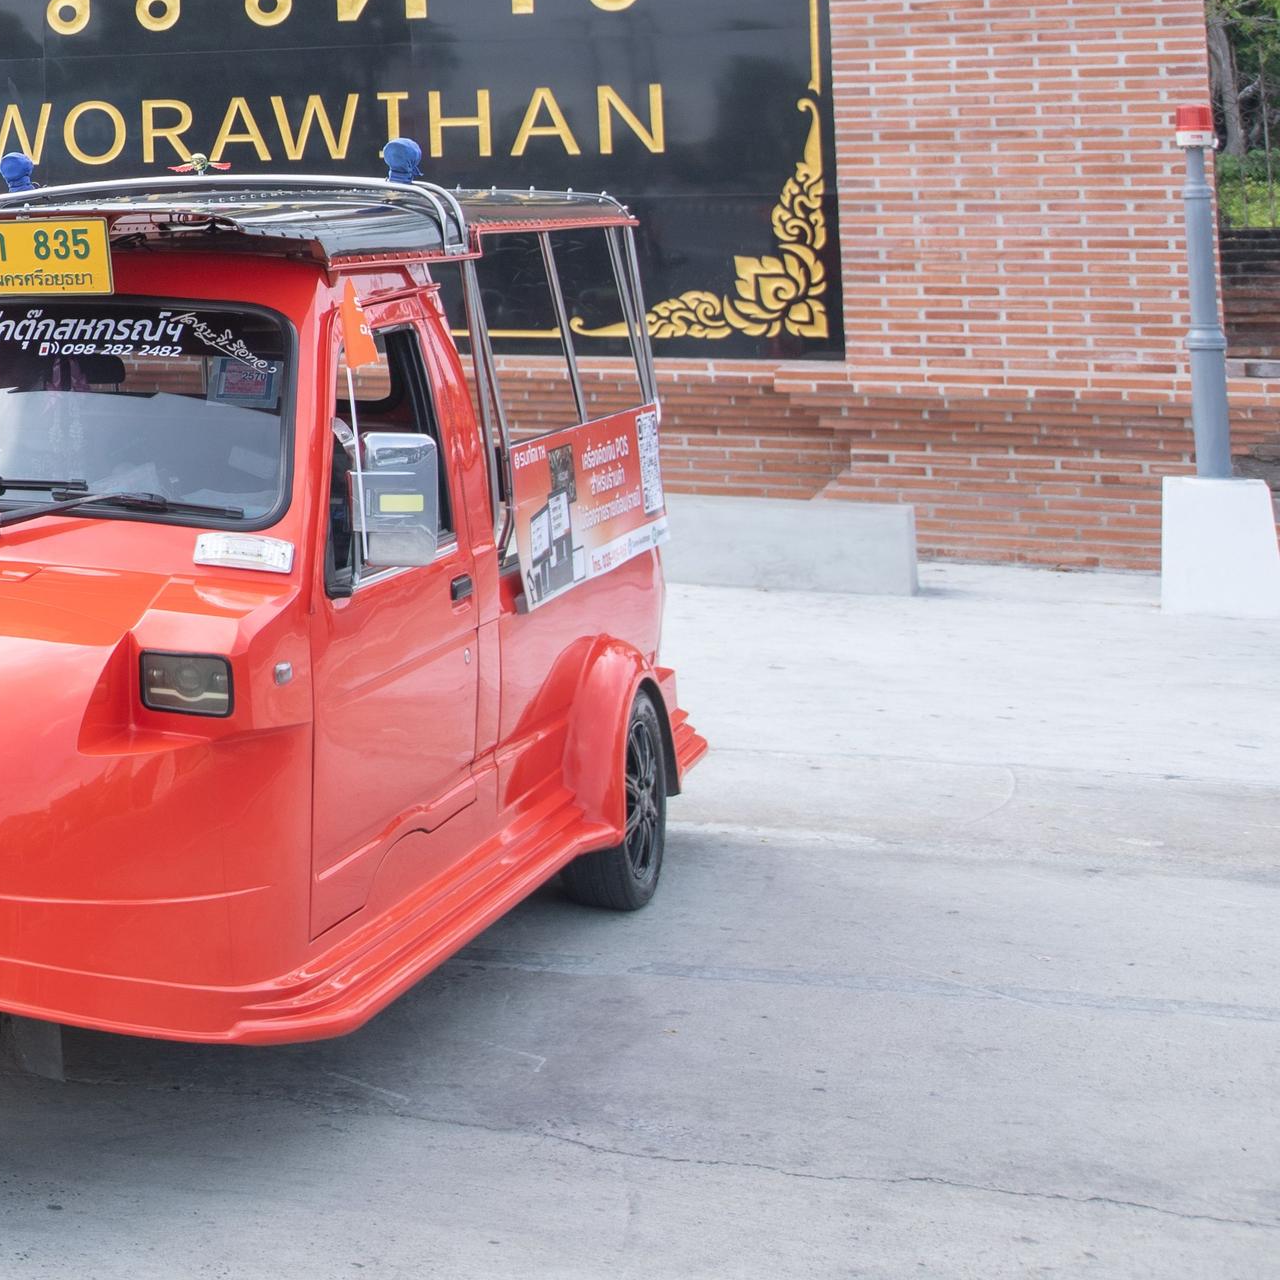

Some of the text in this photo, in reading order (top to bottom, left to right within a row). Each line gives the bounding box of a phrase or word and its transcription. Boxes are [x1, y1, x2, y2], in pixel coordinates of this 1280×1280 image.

[33, 228, 91, 260] 835
[61, 344, 182, 358] 098 282 2482
